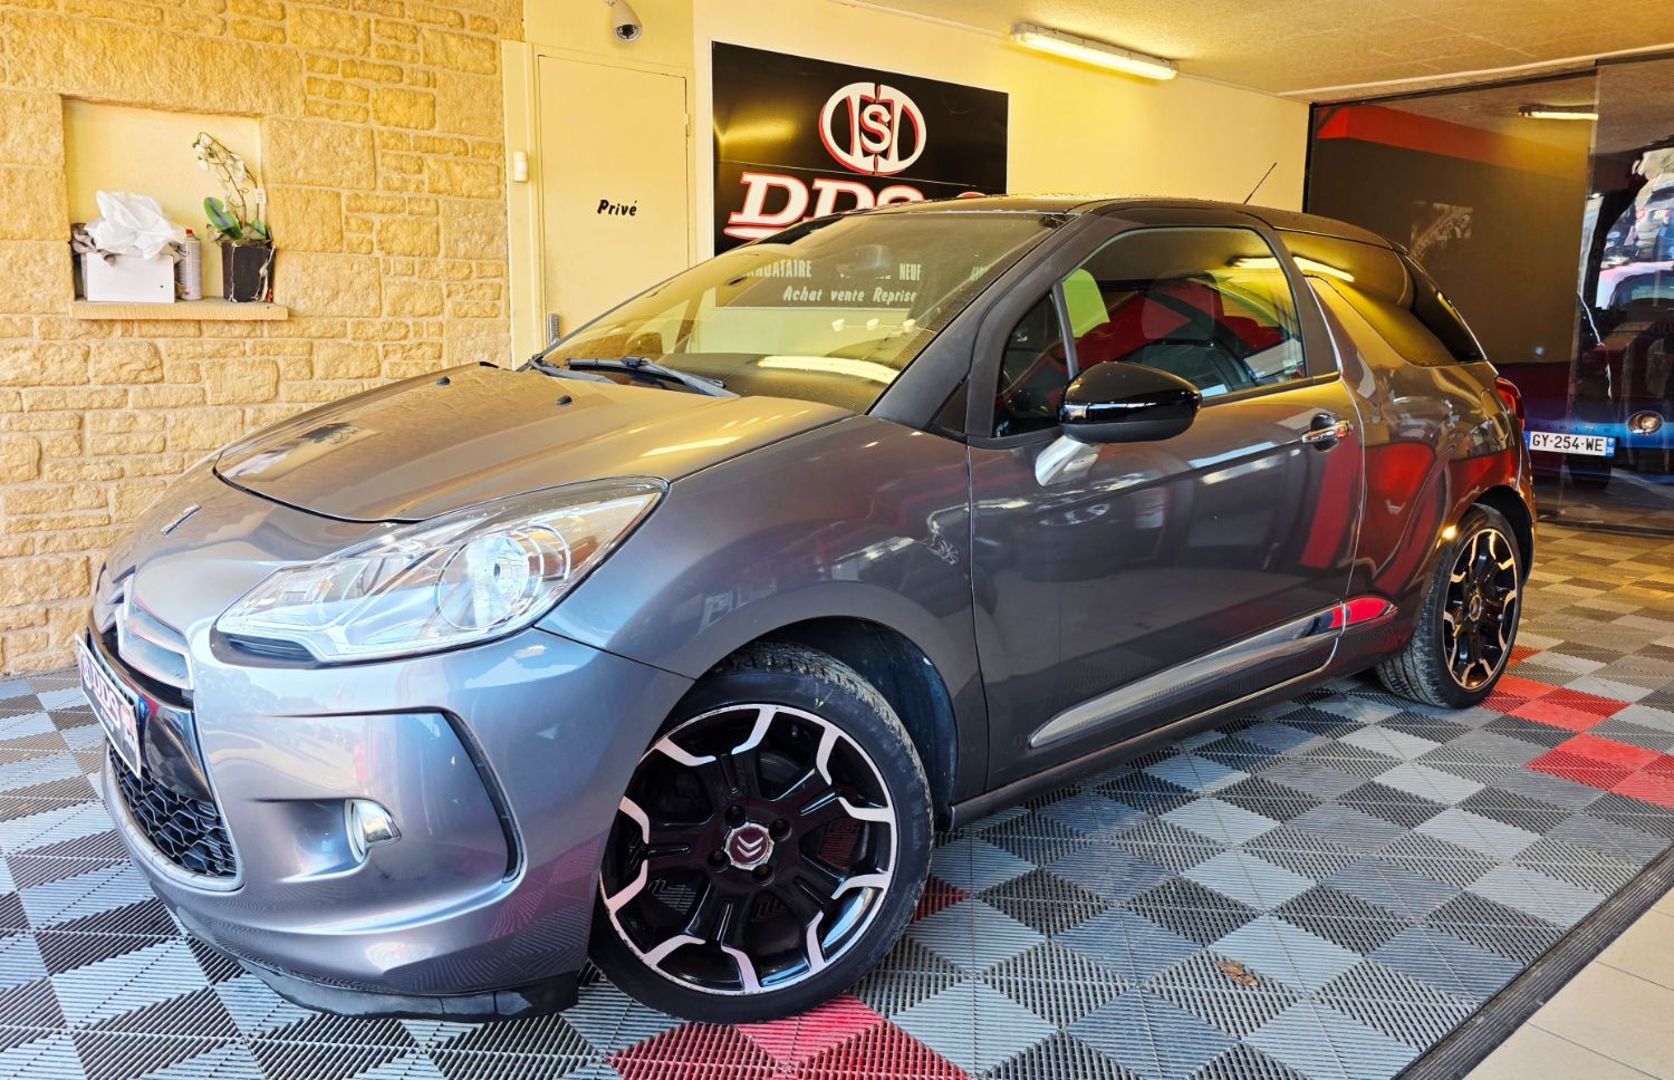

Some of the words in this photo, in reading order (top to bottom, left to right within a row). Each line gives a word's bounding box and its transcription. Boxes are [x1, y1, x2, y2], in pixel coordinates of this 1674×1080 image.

[597, 199, 637, 216] Privé
[783, 285, 823, 302] Achat
[830, 289, 865, 302] vente
[1532, 433, 1604, 452] GY-254-WE
